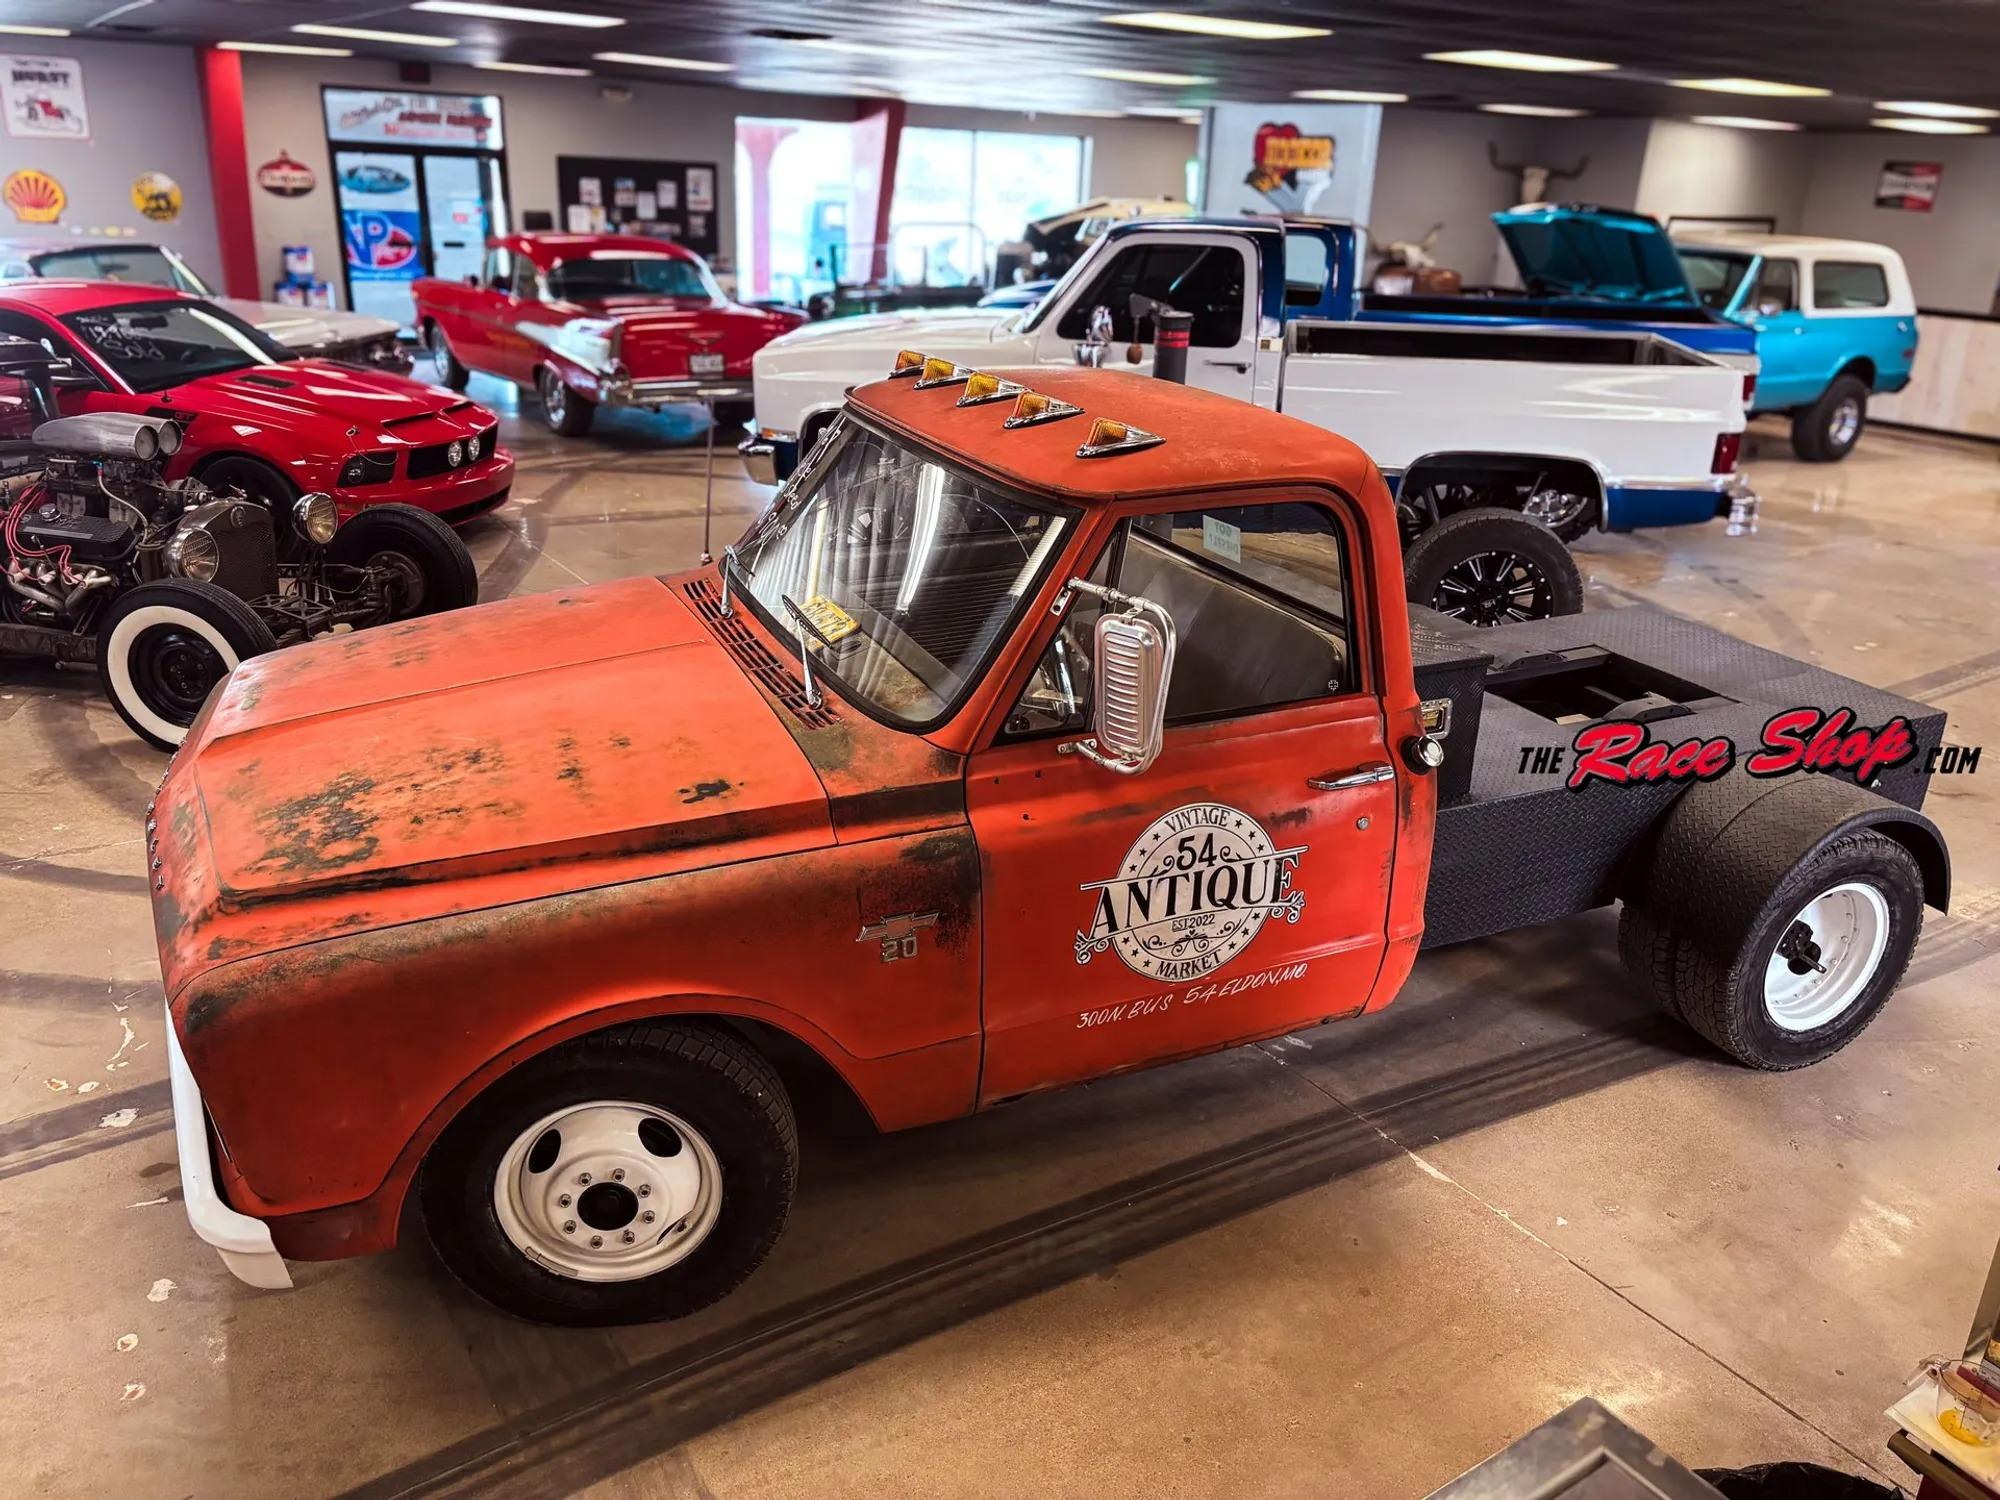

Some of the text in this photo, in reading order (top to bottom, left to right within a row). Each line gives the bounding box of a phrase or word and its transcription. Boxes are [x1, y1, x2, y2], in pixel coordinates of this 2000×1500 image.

[1164, 807, 1231, 833] VINTAGE
[1176, 832, 1218, 871] 54
[1090, 852, 1300, 940] ANTIQUE
[881, 936, 918, 962] 20
[1155, 950, 1222, 979] MARKET
[1128, 994, 1174, 1019] BUS
